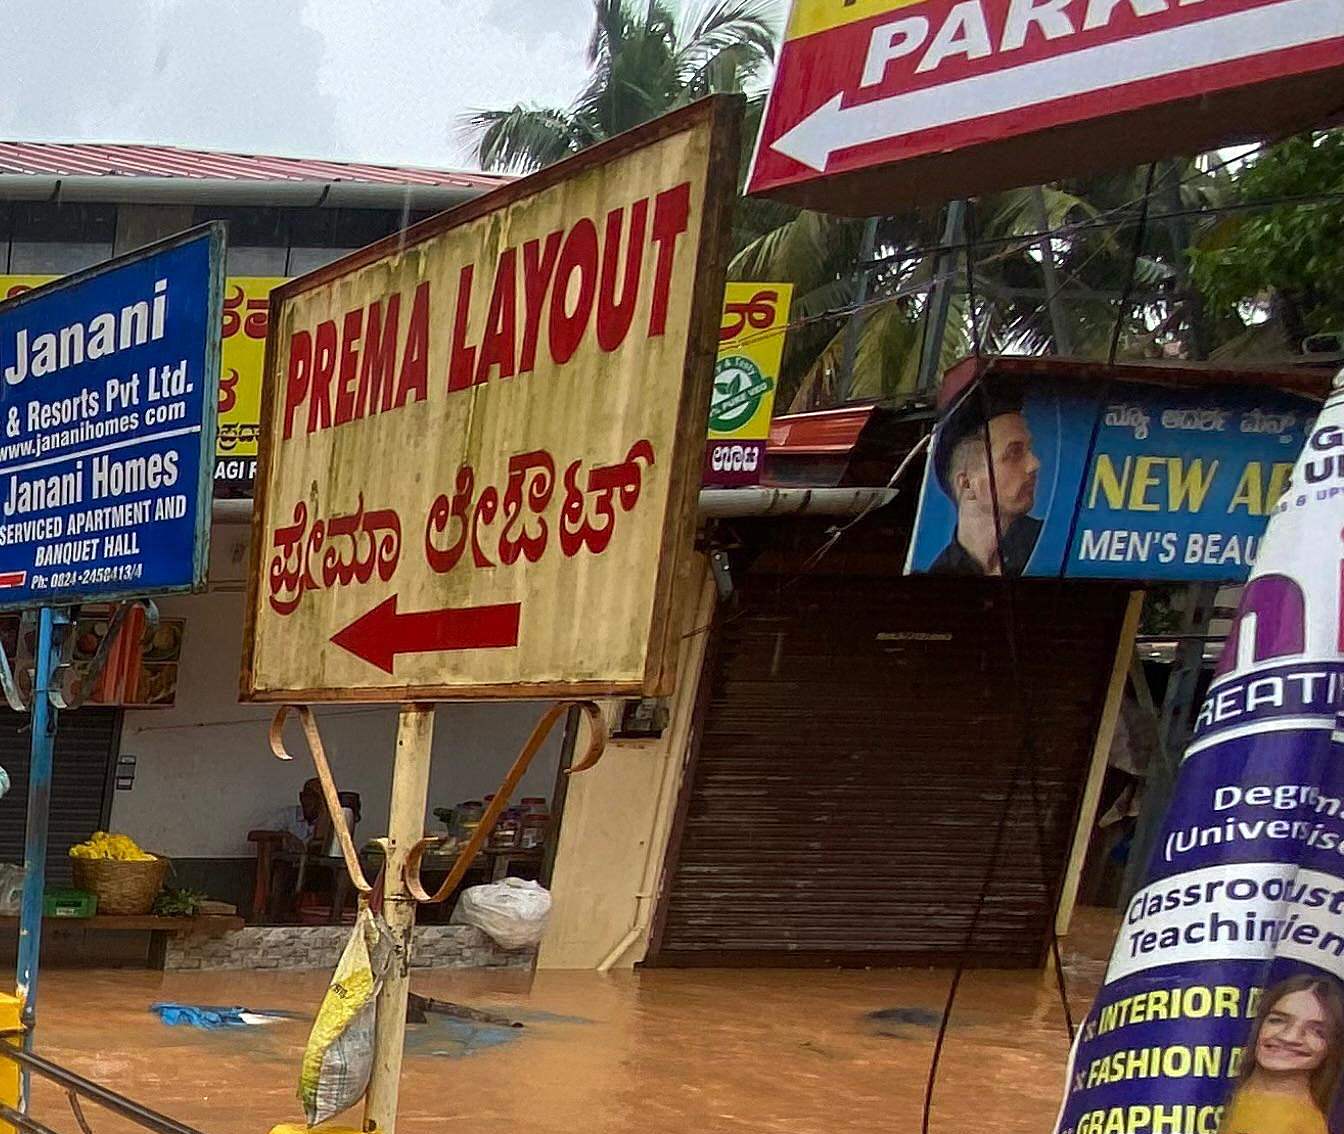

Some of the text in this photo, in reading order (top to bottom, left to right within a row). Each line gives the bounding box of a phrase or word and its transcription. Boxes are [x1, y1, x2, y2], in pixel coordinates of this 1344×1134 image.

[4, 278, 167, 385] Janani
[283, 181, 691, 441] PREMA LAYOUT
[6, 405, 21, 438] &
[27, 387, 100, 432] Resorts
[106, 372, 140, 413] Pvt
[148, 359, 194, 401] Ltd.
[3, 450, 179, 517] Janani Homes
[1088, 453, 1220, 513] NEW
[67, 499, 154, 536] APARTMENT
[155, 494, 186, 522] AND
[34, 532, 140, 568] BANQUET HALL
[1078, 529, 1179, 563] MEN'S
[1098, 986, 1241, 1036] INTERIOR
[1086, 1045, 1221, 1089] FASHION
